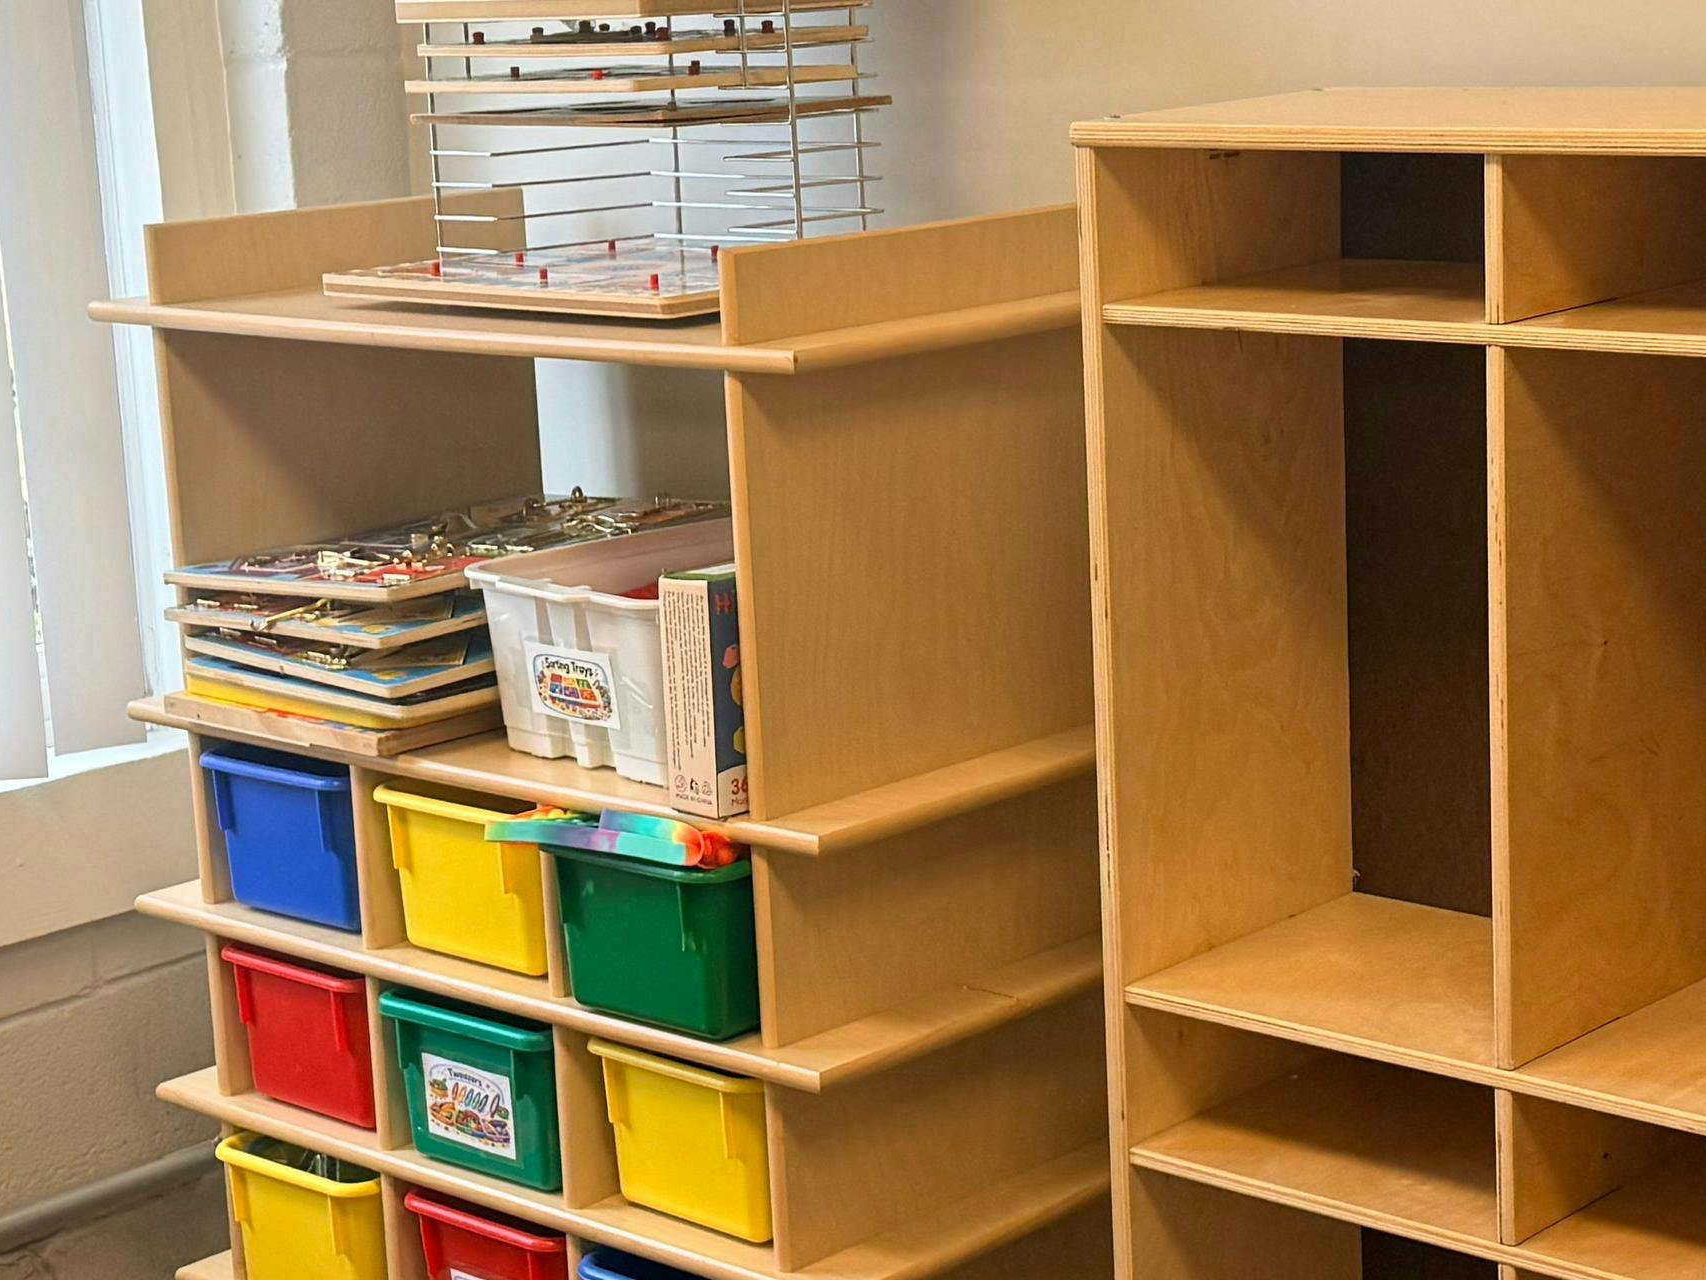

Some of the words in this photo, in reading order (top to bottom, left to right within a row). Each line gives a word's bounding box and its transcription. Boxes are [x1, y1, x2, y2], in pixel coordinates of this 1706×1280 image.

[543, 656, 571, 675] Sorting
[570, 661, 594, 678] Trays
[447, 1067, 483, 1088] Tweezers
